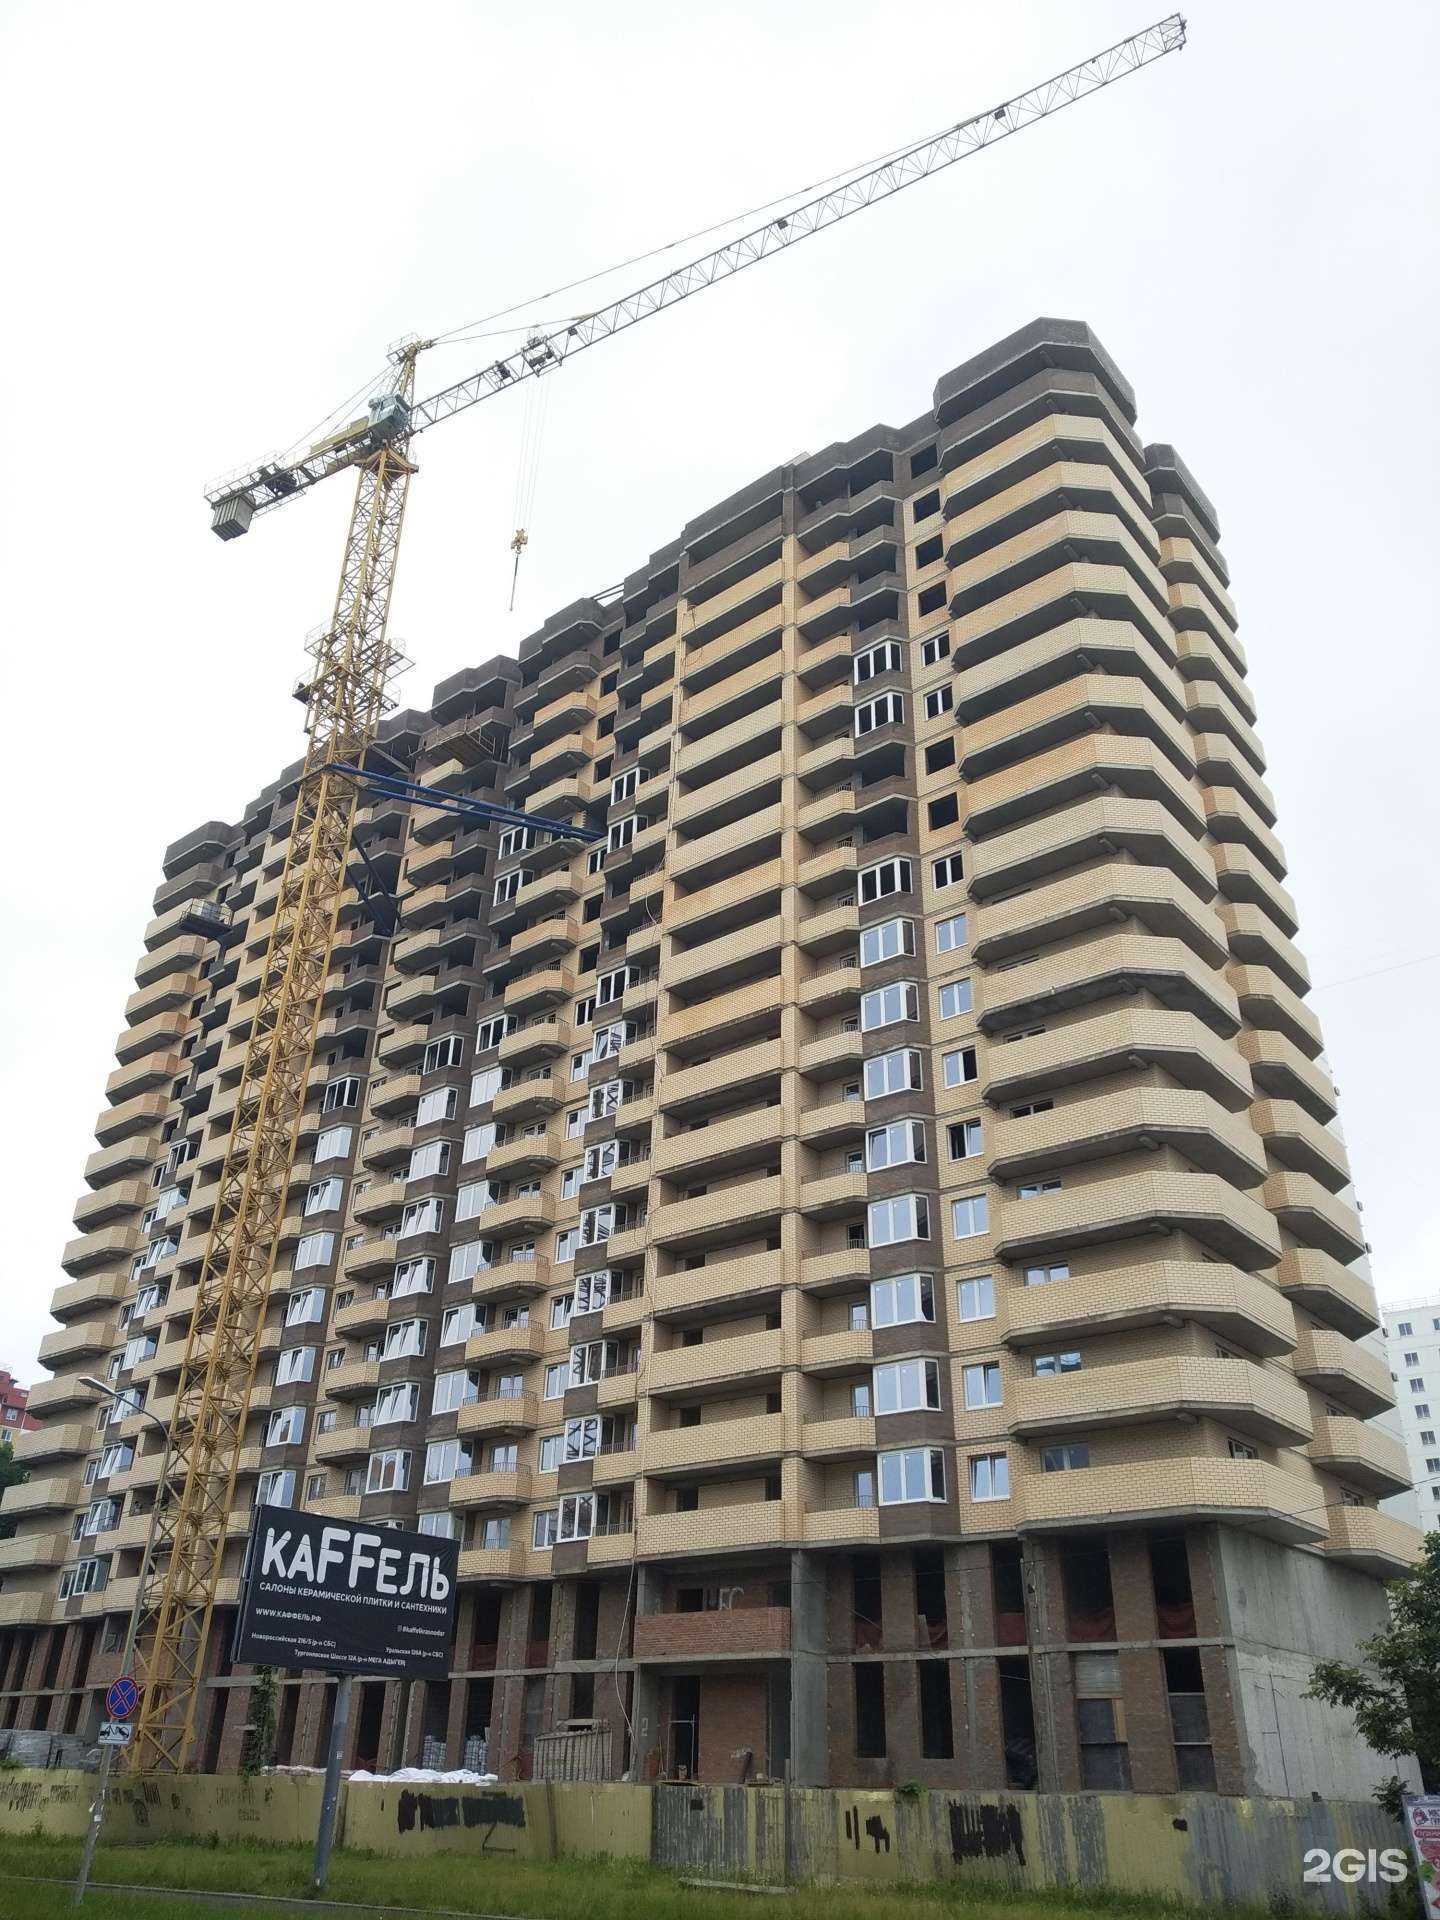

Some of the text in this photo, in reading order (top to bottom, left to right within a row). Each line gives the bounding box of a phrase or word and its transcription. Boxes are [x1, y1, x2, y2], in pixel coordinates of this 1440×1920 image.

[259, 1582, 448, 1615] САЛОНЫ КЕРАМИЧЕСКОЙ ПЛИТКИ И САНТЕХНИКИ
